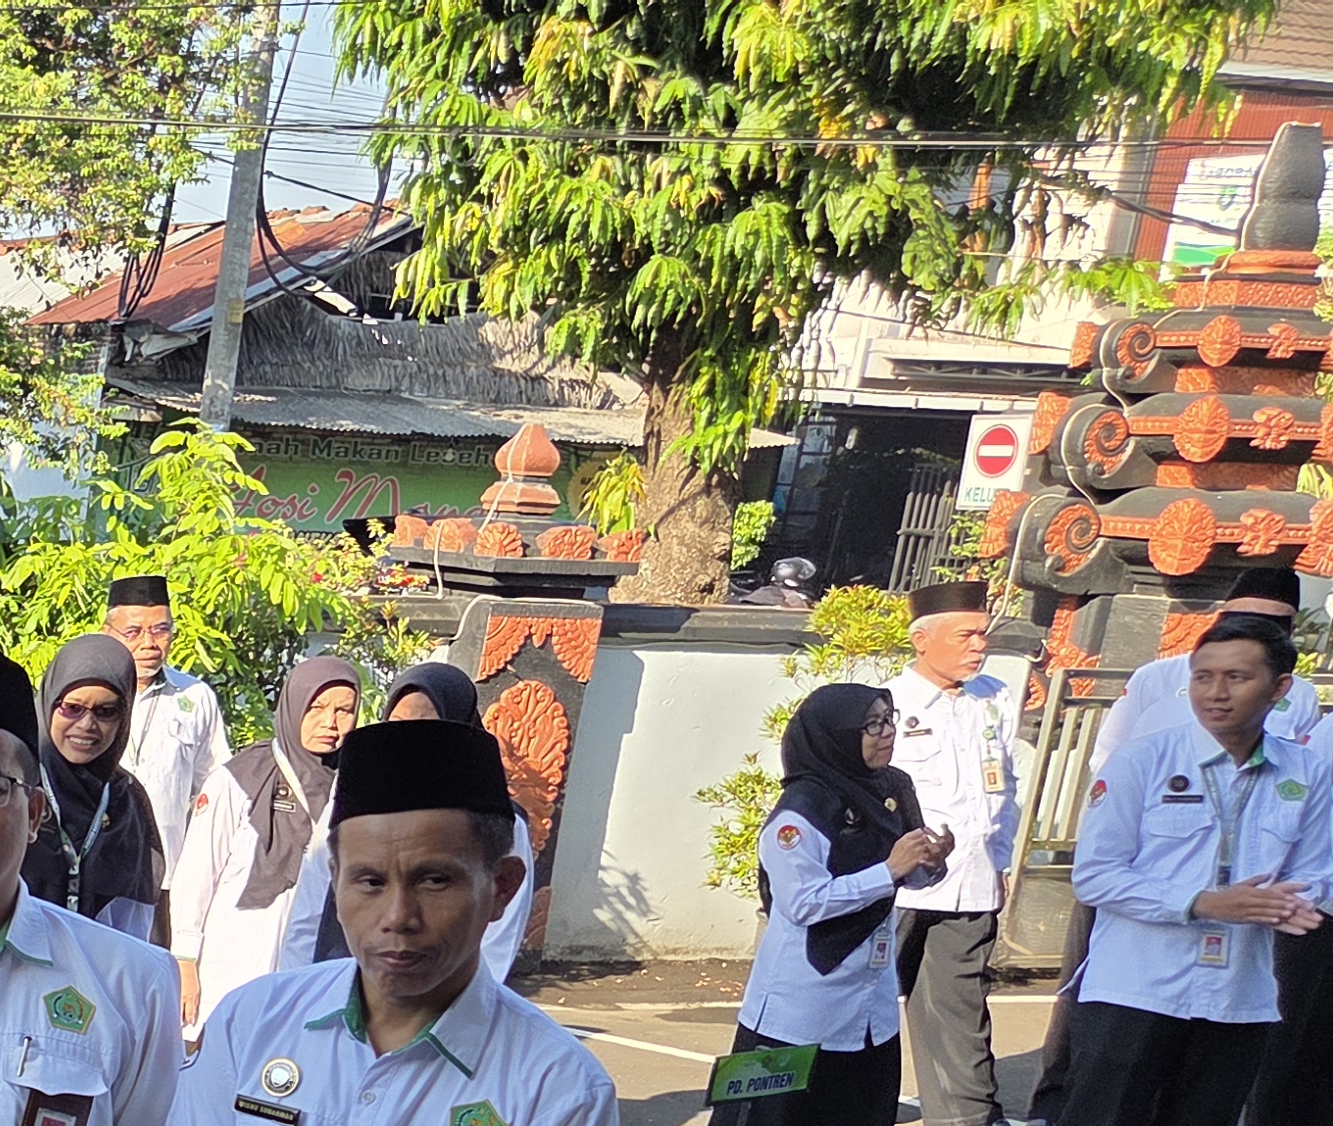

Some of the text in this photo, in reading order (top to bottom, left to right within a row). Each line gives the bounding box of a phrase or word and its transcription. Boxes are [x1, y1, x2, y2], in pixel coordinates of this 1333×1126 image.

[312, 437, 400, 462] Makan
[964, 487, 994, 503] KELU
[726, 1072, 795, 1096] PD. PONTREN
